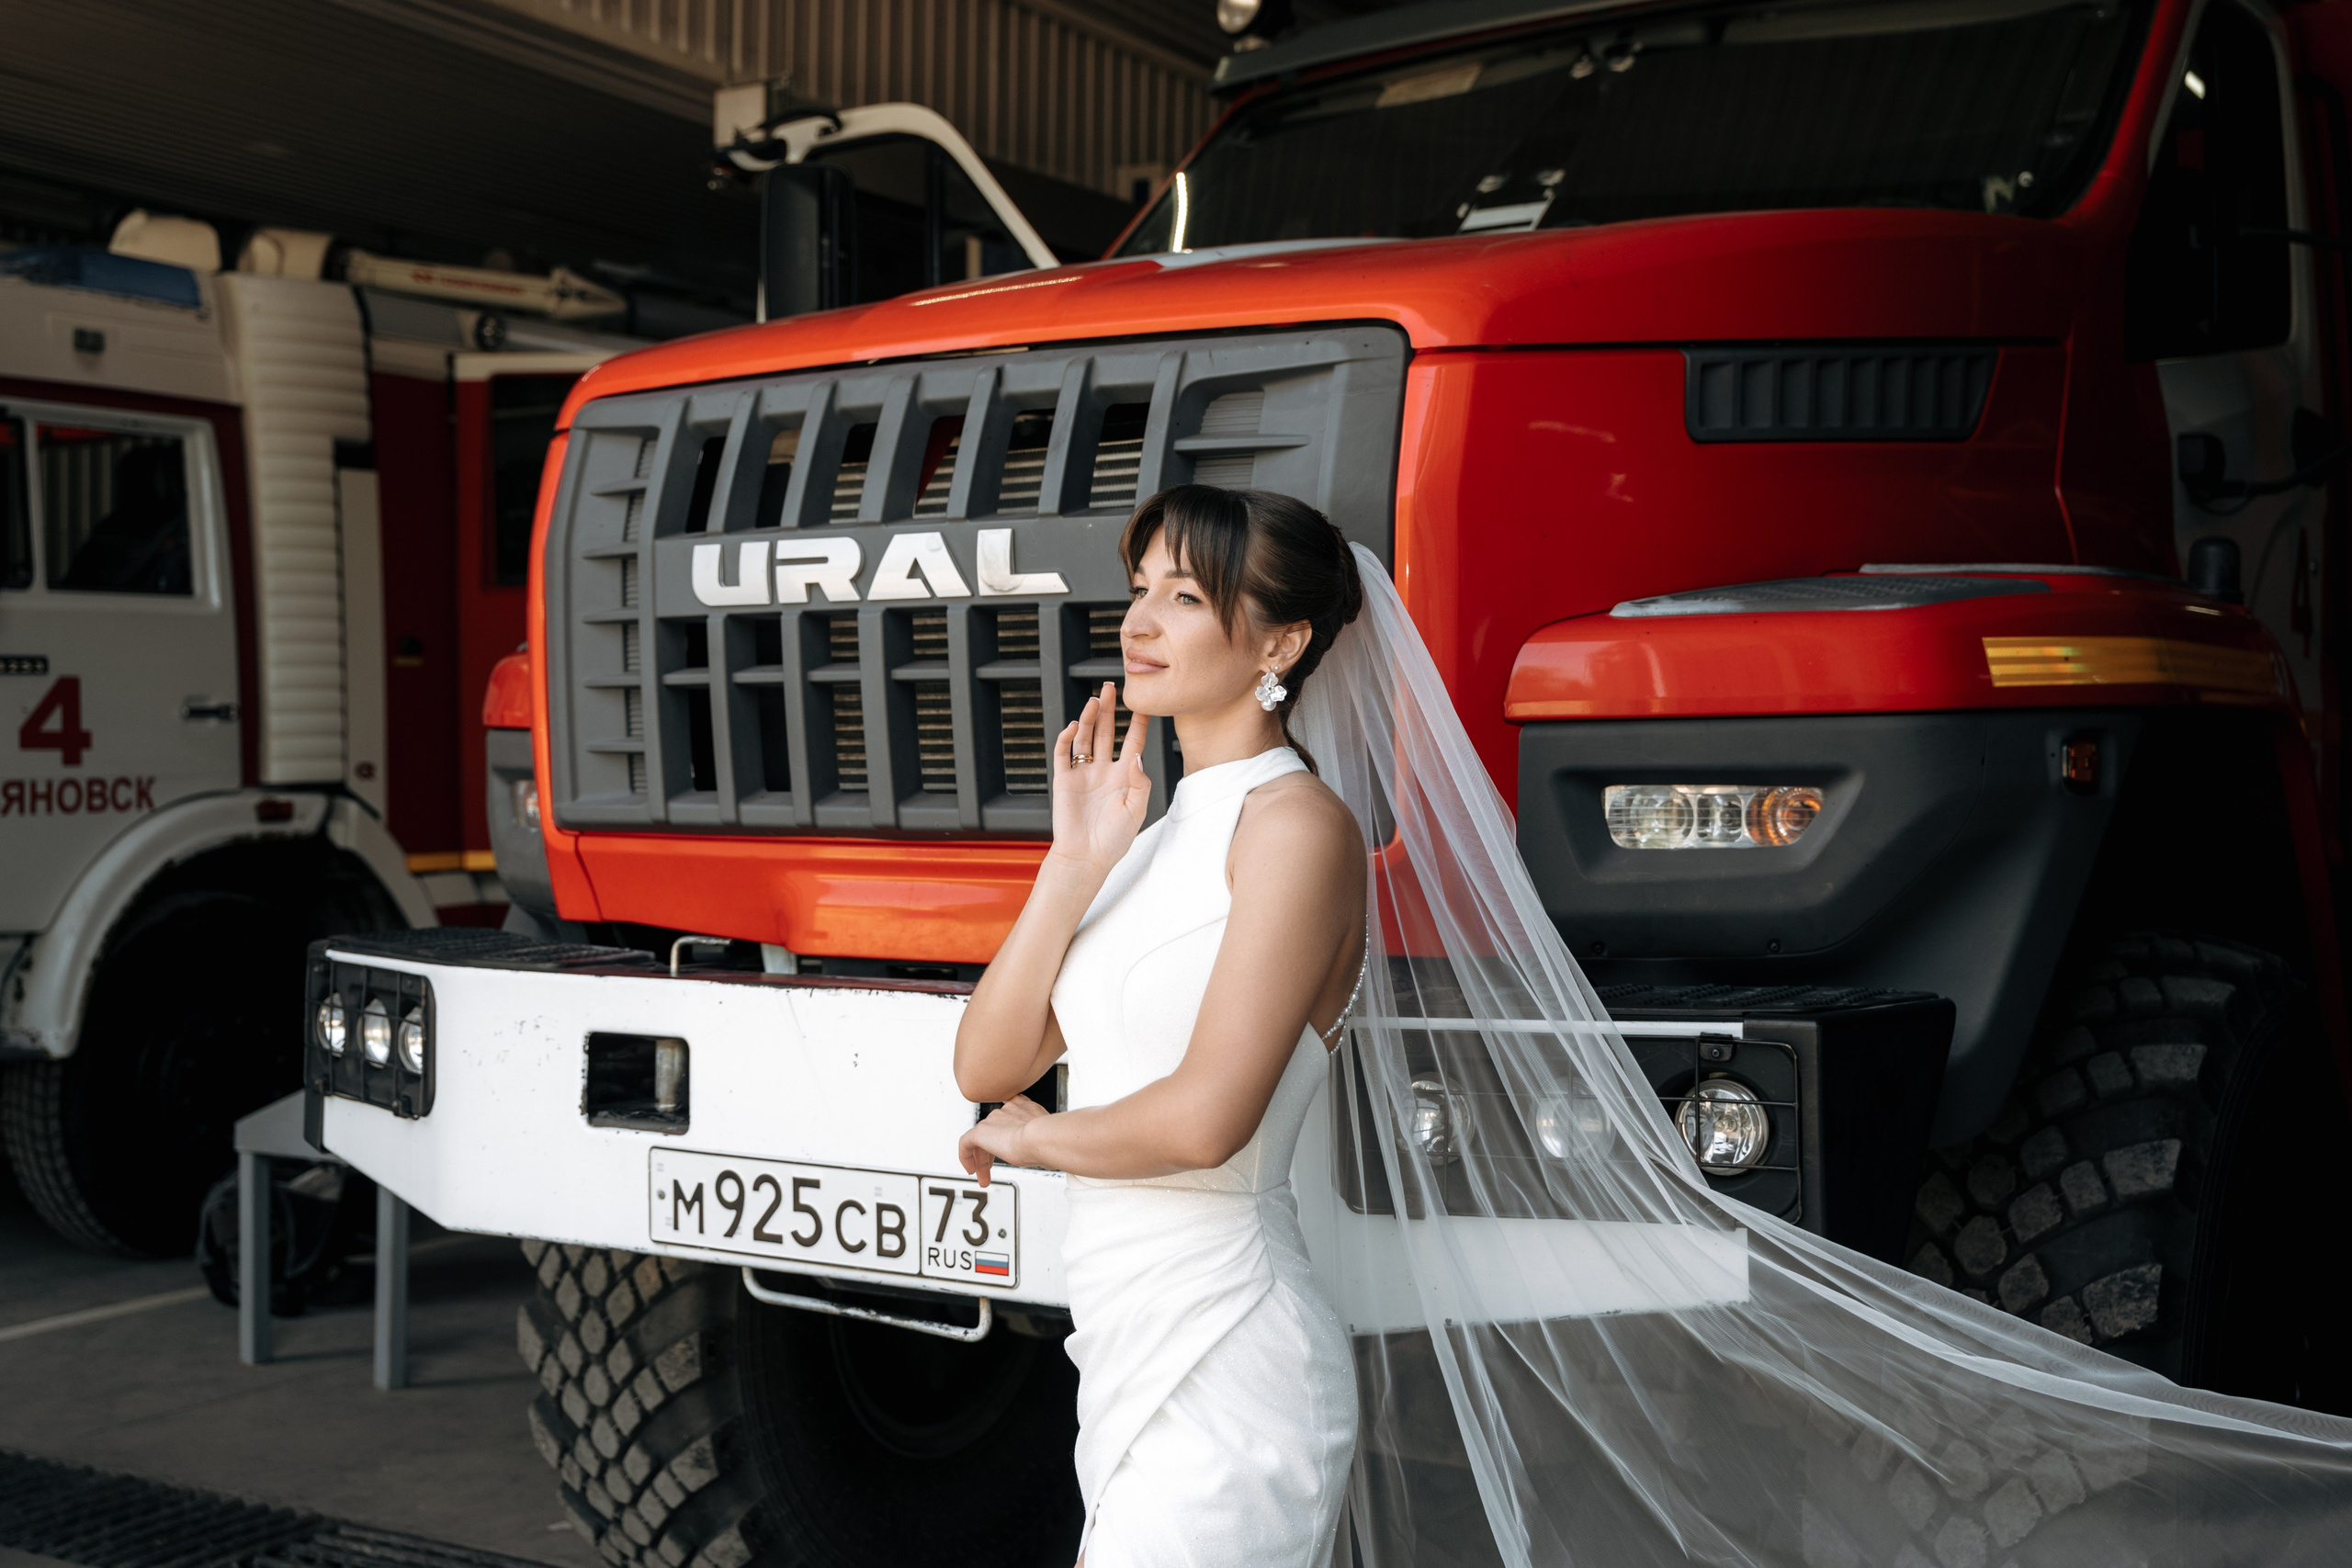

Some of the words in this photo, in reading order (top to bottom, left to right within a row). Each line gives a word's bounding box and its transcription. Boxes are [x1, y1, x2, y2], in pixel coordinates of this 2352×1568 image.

[691, 527, 1072, 607] URAL
[20, 676, 91, 765] 4
[1, 776, 155, 815] ЯНОВСК
[928, 1186, 989, 1247] 73
[927, 1247, 973, 1270] RUS
